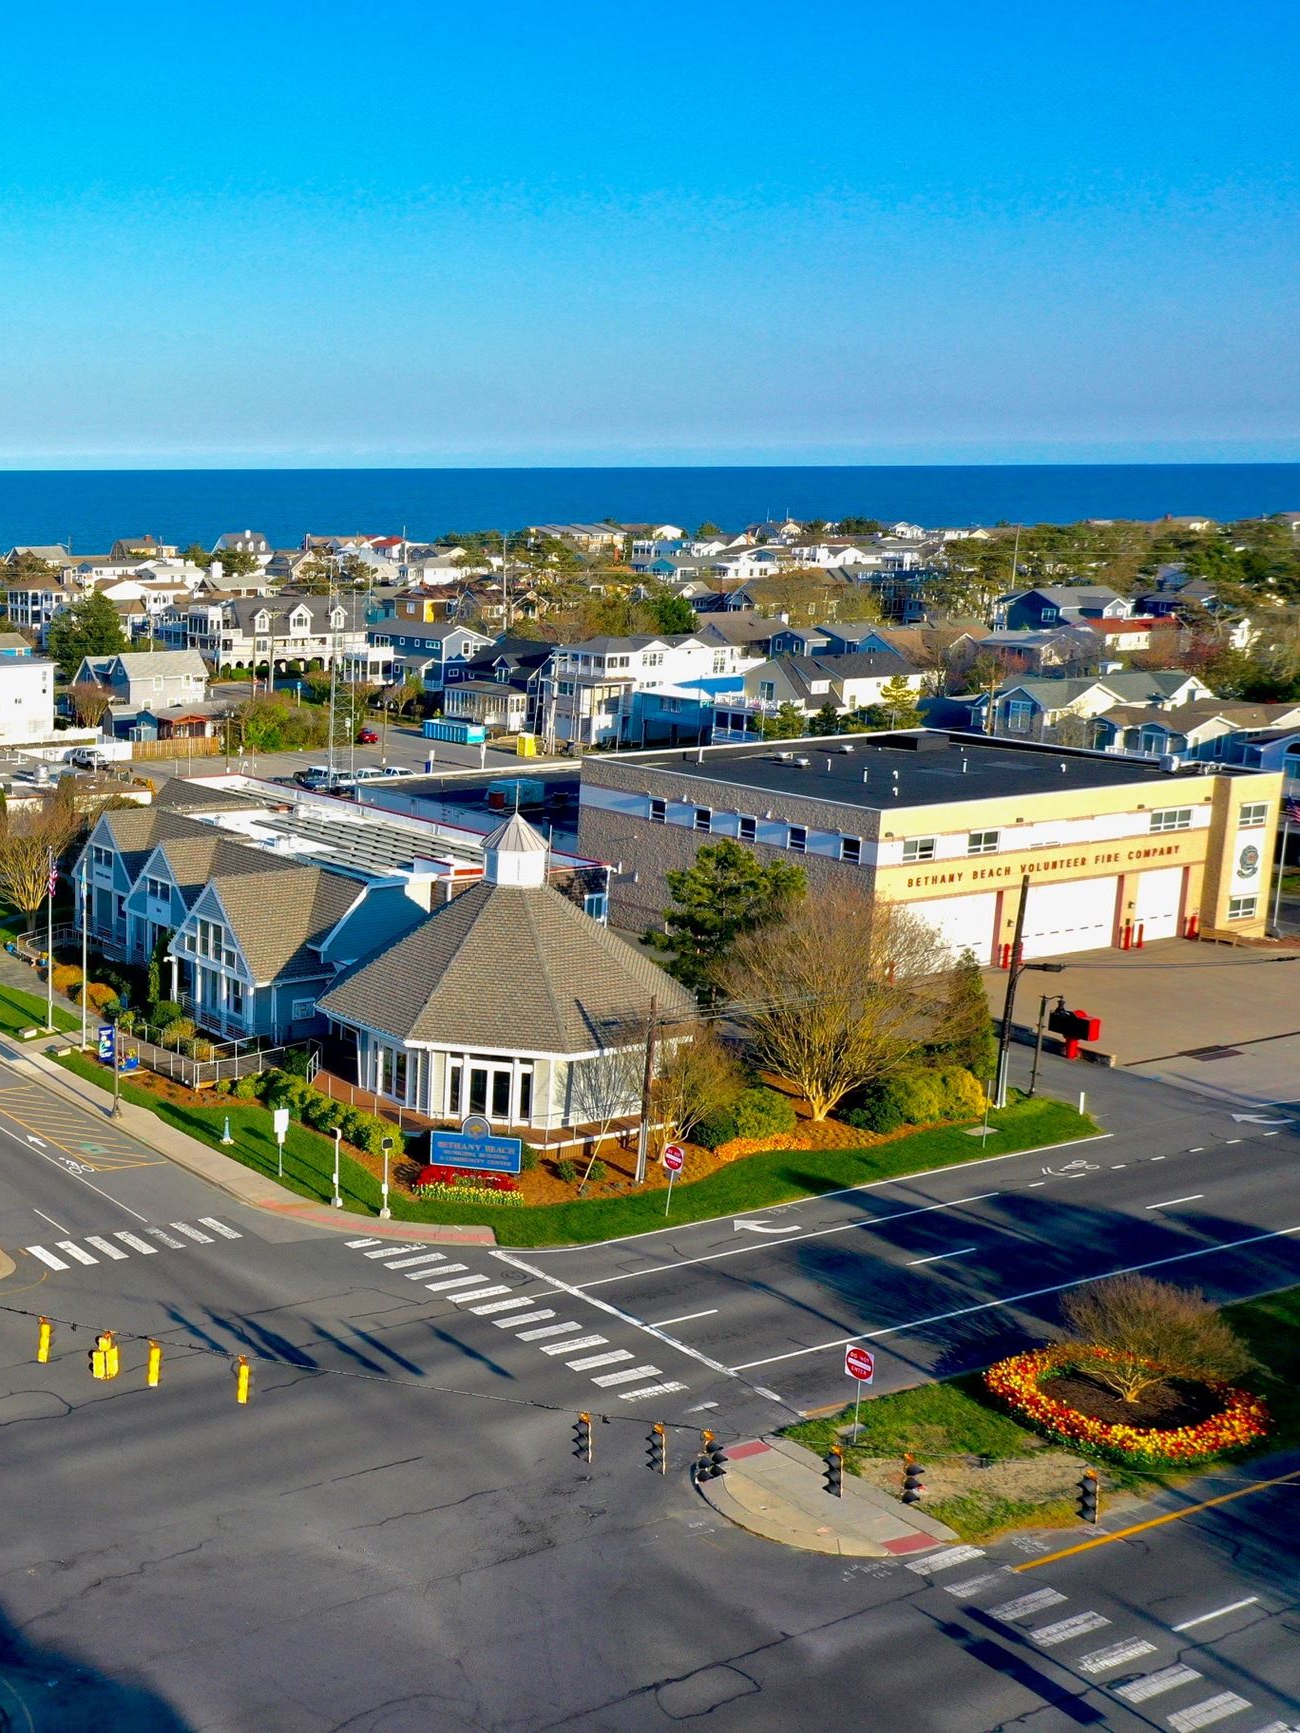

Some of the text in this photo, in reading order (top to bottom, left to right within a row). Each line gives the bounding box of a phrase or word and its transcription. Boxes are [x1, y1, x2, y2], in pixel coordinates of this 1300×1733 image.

[907, 845, 1180, 888] BETHANY BEACH VOLUNTEER FIRE COMPANY
[437, 1141, 516, 1154] BETHANY BEACH
[850, 1351, 870, 1364] DO NOT
[851, 1365, 867, 1376] ENTER
